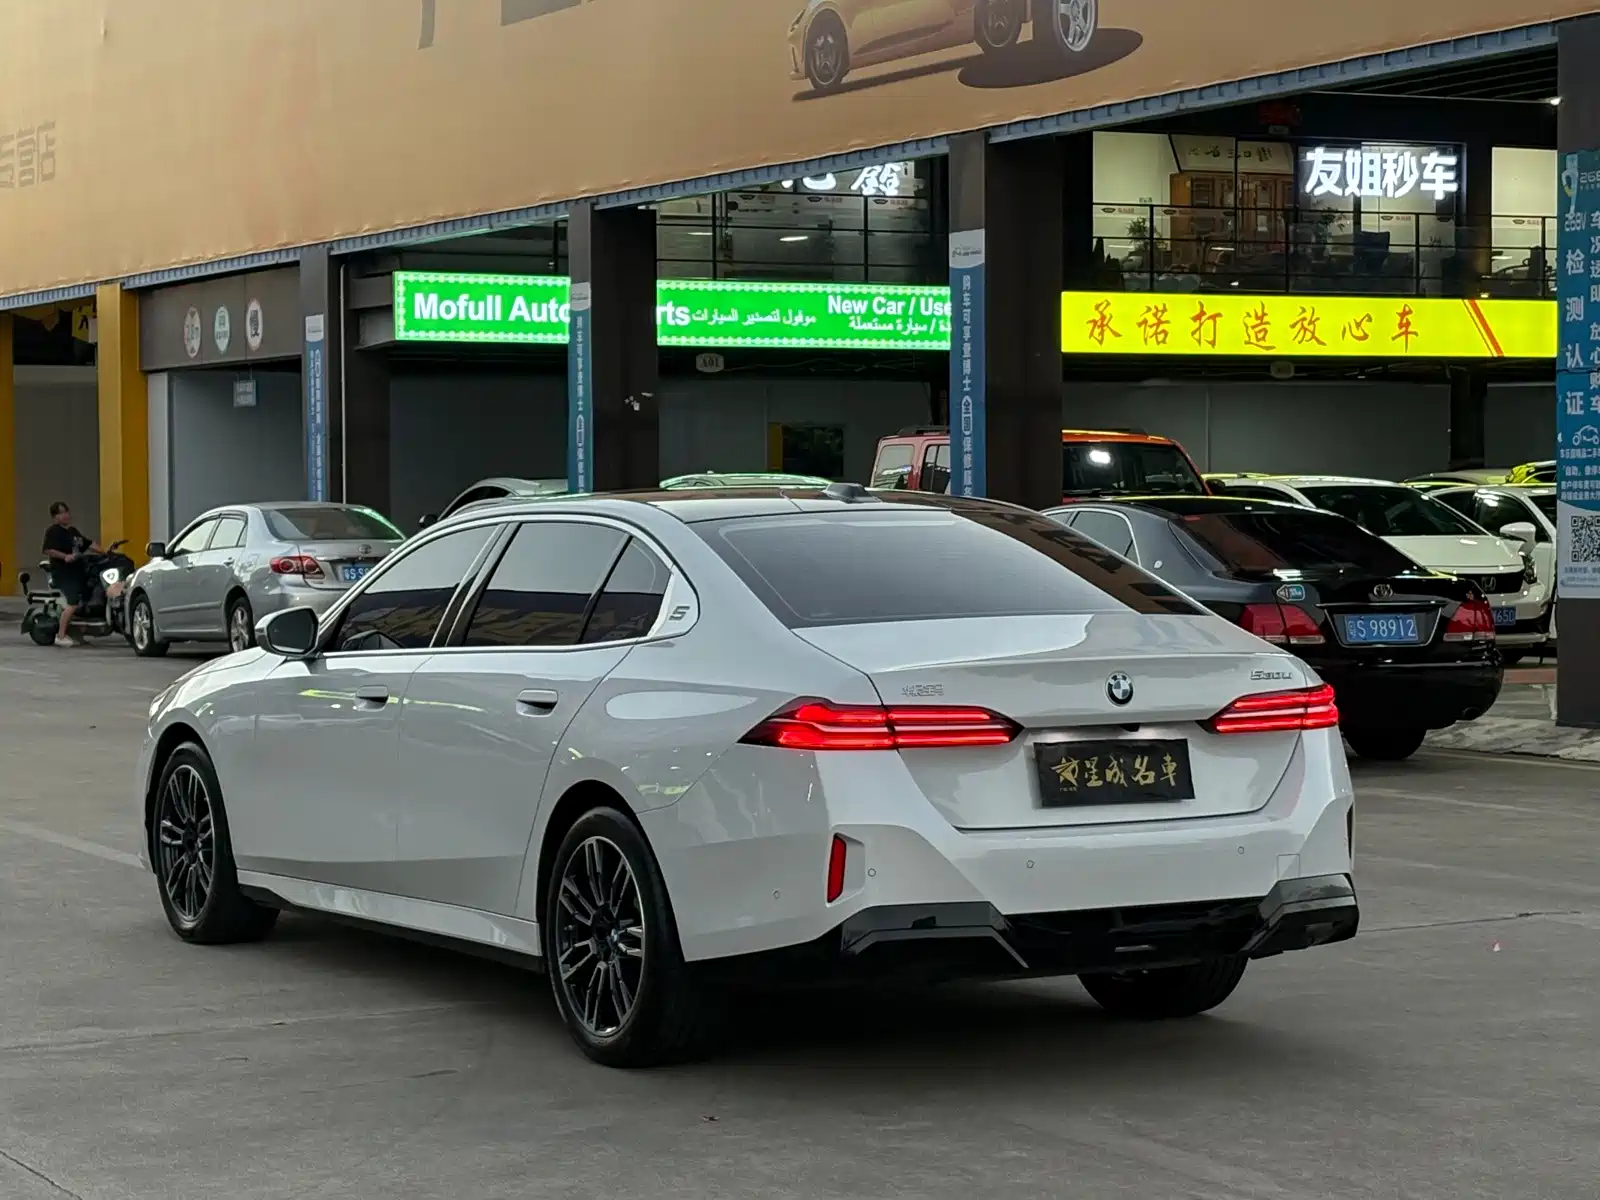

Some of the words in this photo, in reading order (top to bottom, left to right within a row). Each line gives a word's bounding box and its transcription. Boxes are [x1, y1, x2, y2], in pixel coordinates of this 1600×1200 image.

[1304, 147, 1458, 200] 友姐秒车
[414, 293, 502, 320] Mofull
[508, 295, 569, 323] Auto
[827, 295, 868, 314] New
[872, 296, 906, 315] Car
[1086, 300, 1419, 353] 承诺打造放心车
